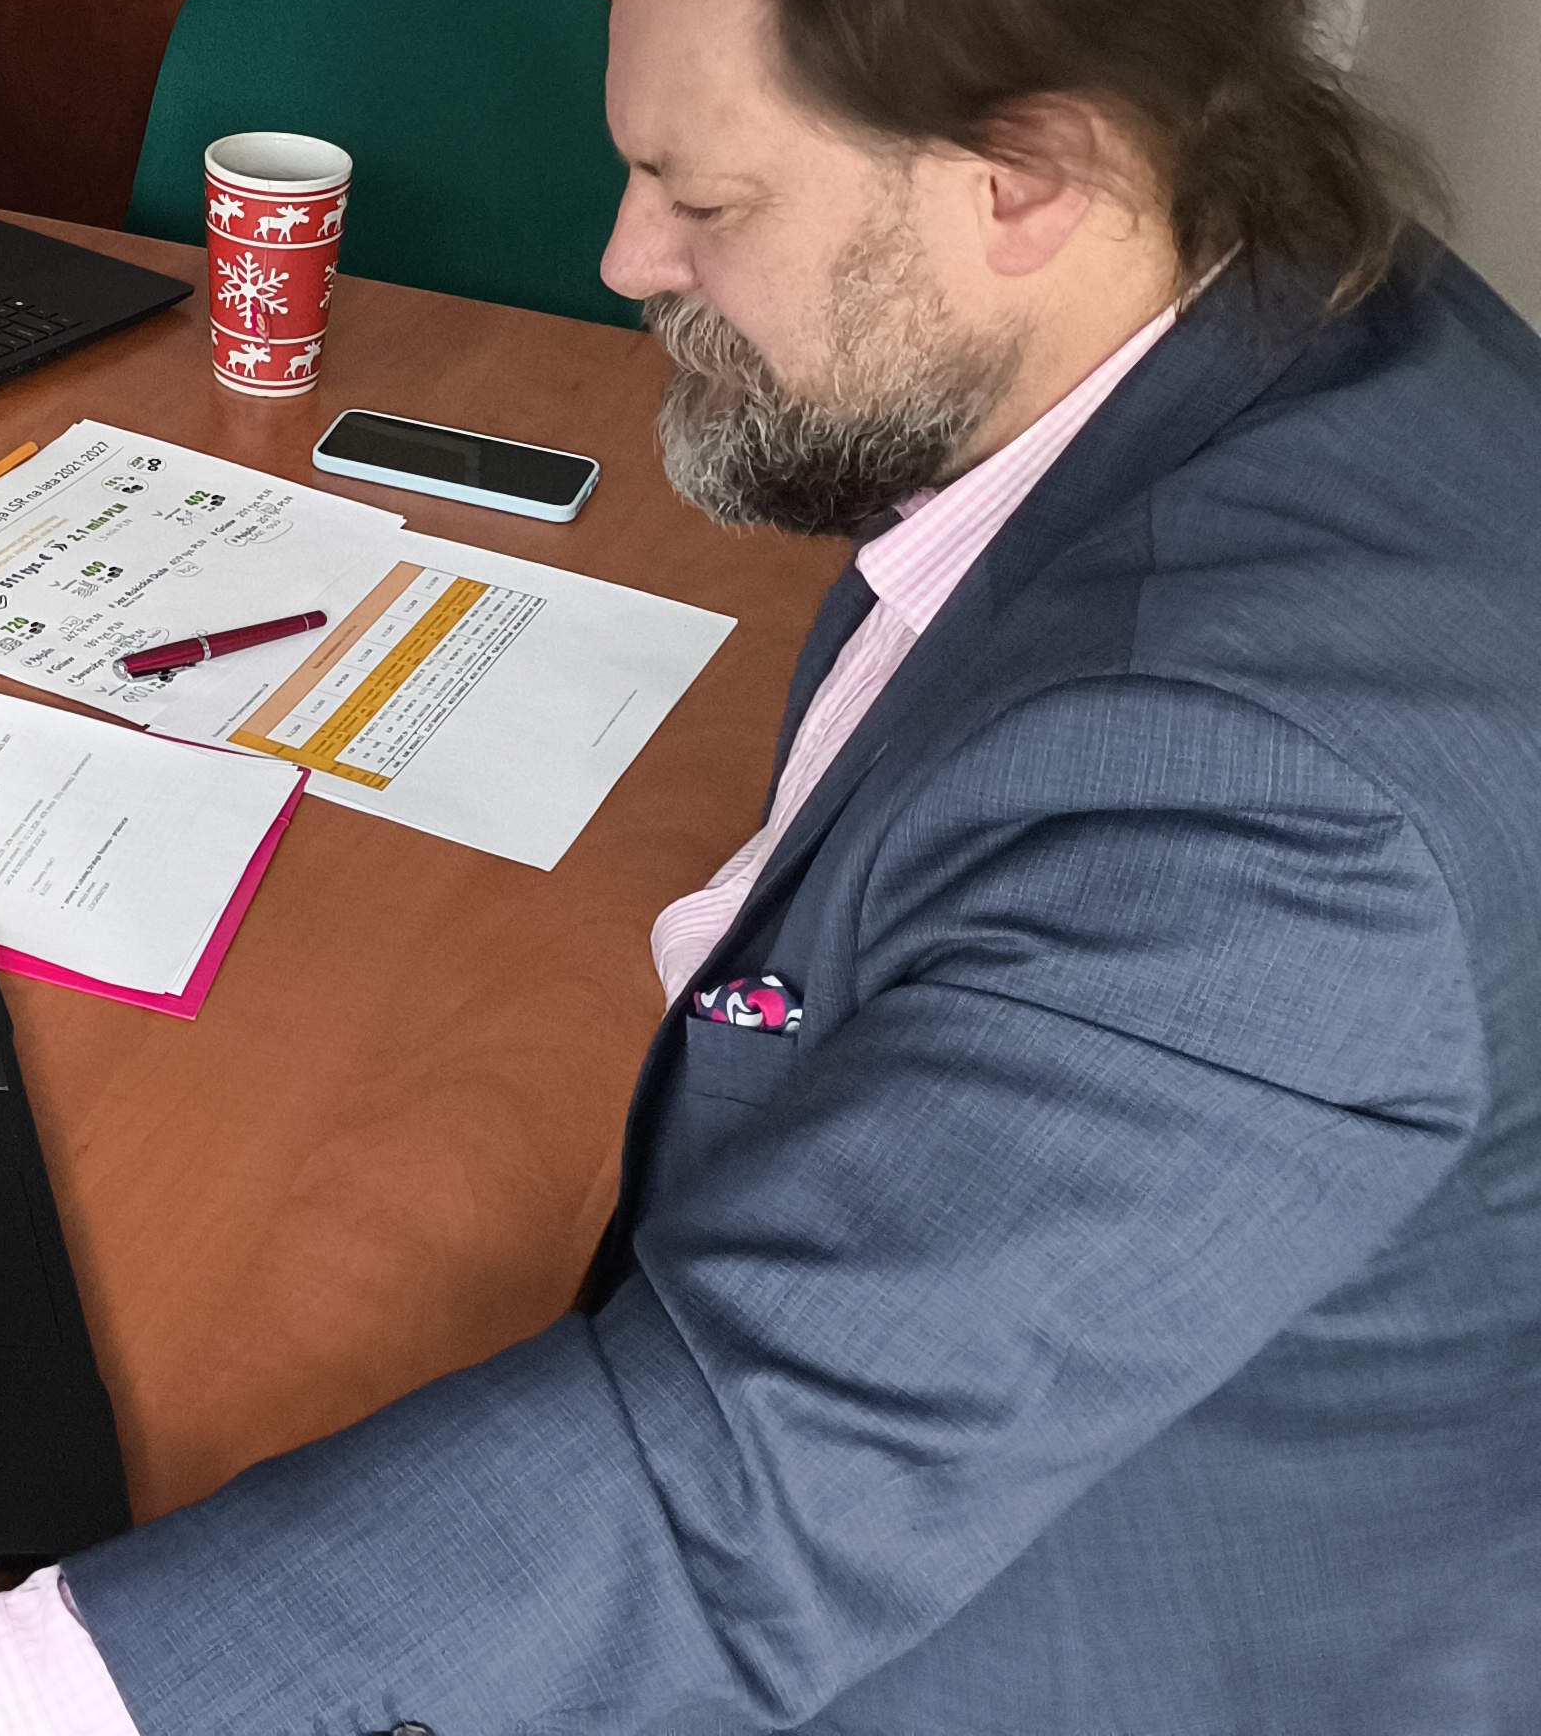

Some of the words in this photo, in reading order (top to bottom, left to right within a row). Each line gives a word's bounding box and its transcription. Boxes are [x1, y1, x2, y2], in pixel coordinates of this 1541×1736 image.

[3, 497, 30, 517] LSR
[26, 487, 42, 501] na
[38, 476, 60, 494] lata
[55, 441, 110, 479] 2021-2027
[184, 490, 211, 507] 402
[85, 514, 110, 531] mln
[104, 503, 128, 519] PLN
[81, 561, 107, 578] 409
[0, 572, 22, 589] 511
[0, 617, 30, 634] 720
